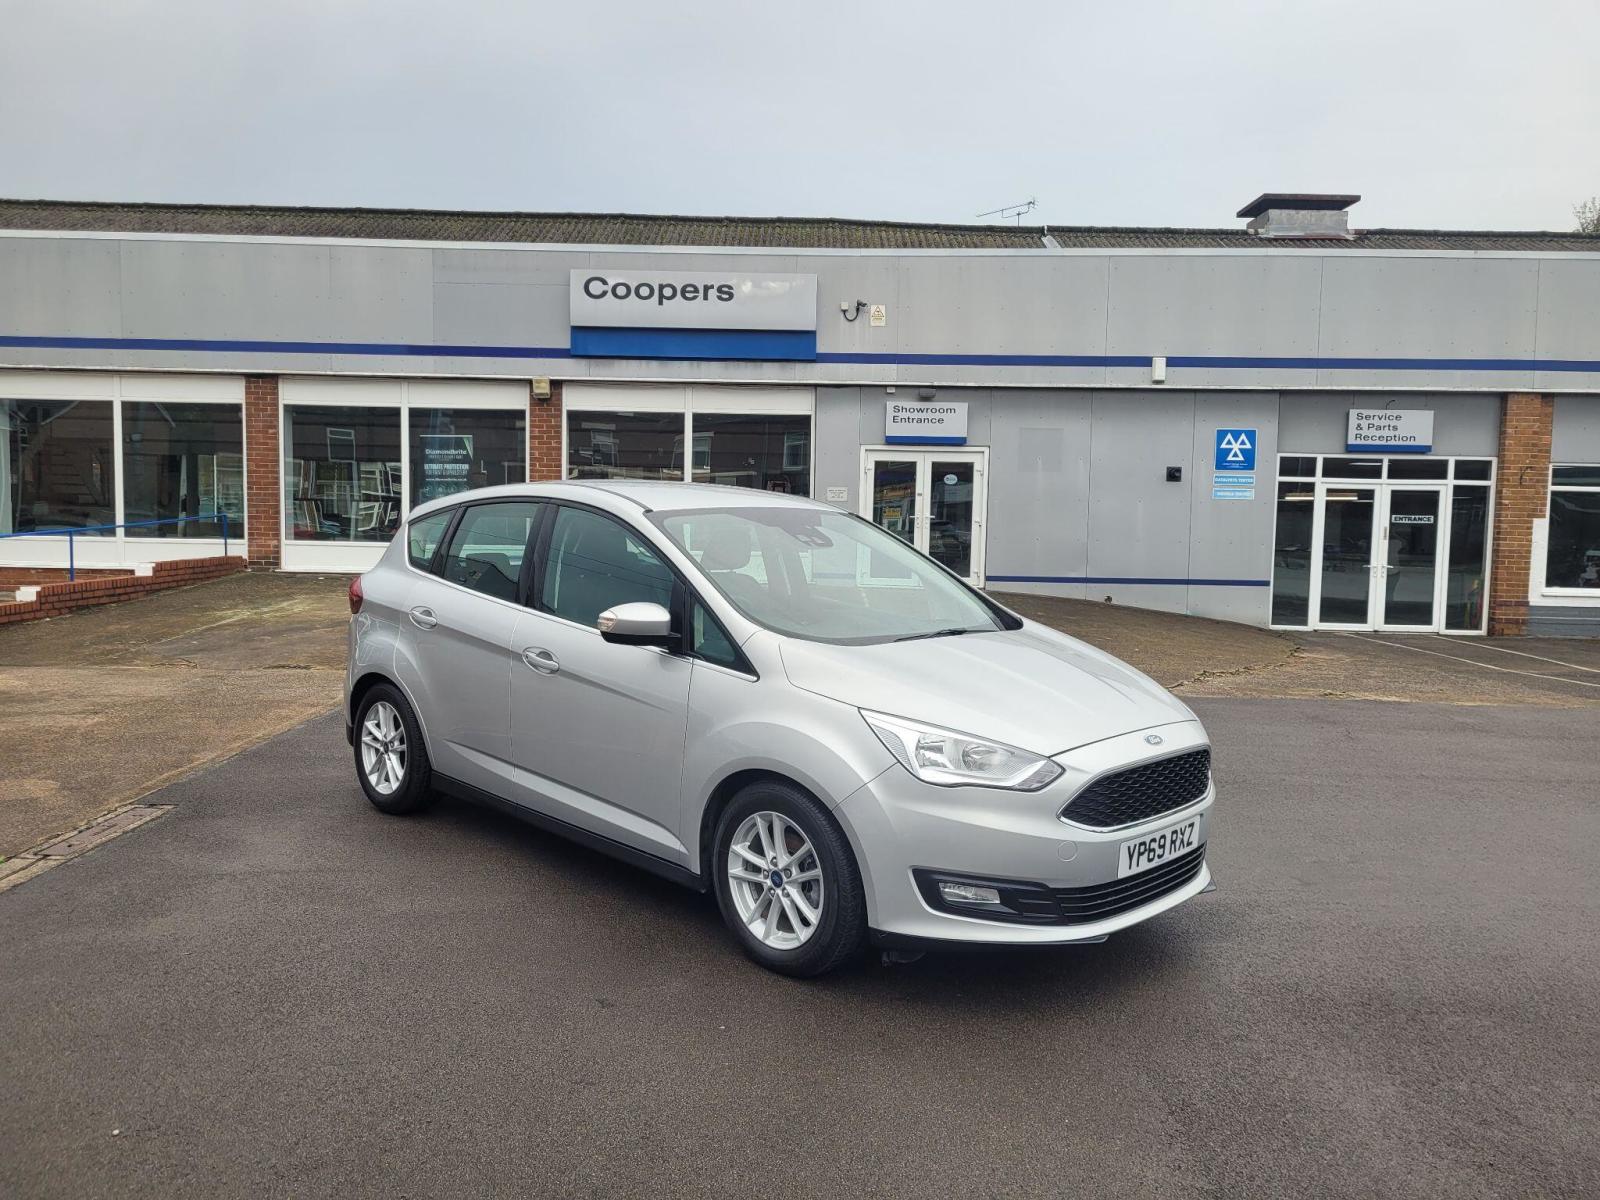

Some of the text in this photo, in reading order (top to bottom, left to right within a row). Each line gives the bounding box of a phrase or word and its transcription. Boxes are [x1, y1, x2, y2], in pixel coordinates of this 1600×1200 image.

[583, 276, 735, 306] Coopers
[892, 405, 957, 414] Showroom
[892, 415, 945, 424] Entrance
[1356, 412, 1402, 421] Service
[1355, 423, 1399, 432] & Parts
[1354, 433, 1417, 443] Reception
[1127, 821, 1195, 871] YP69 RXZ
